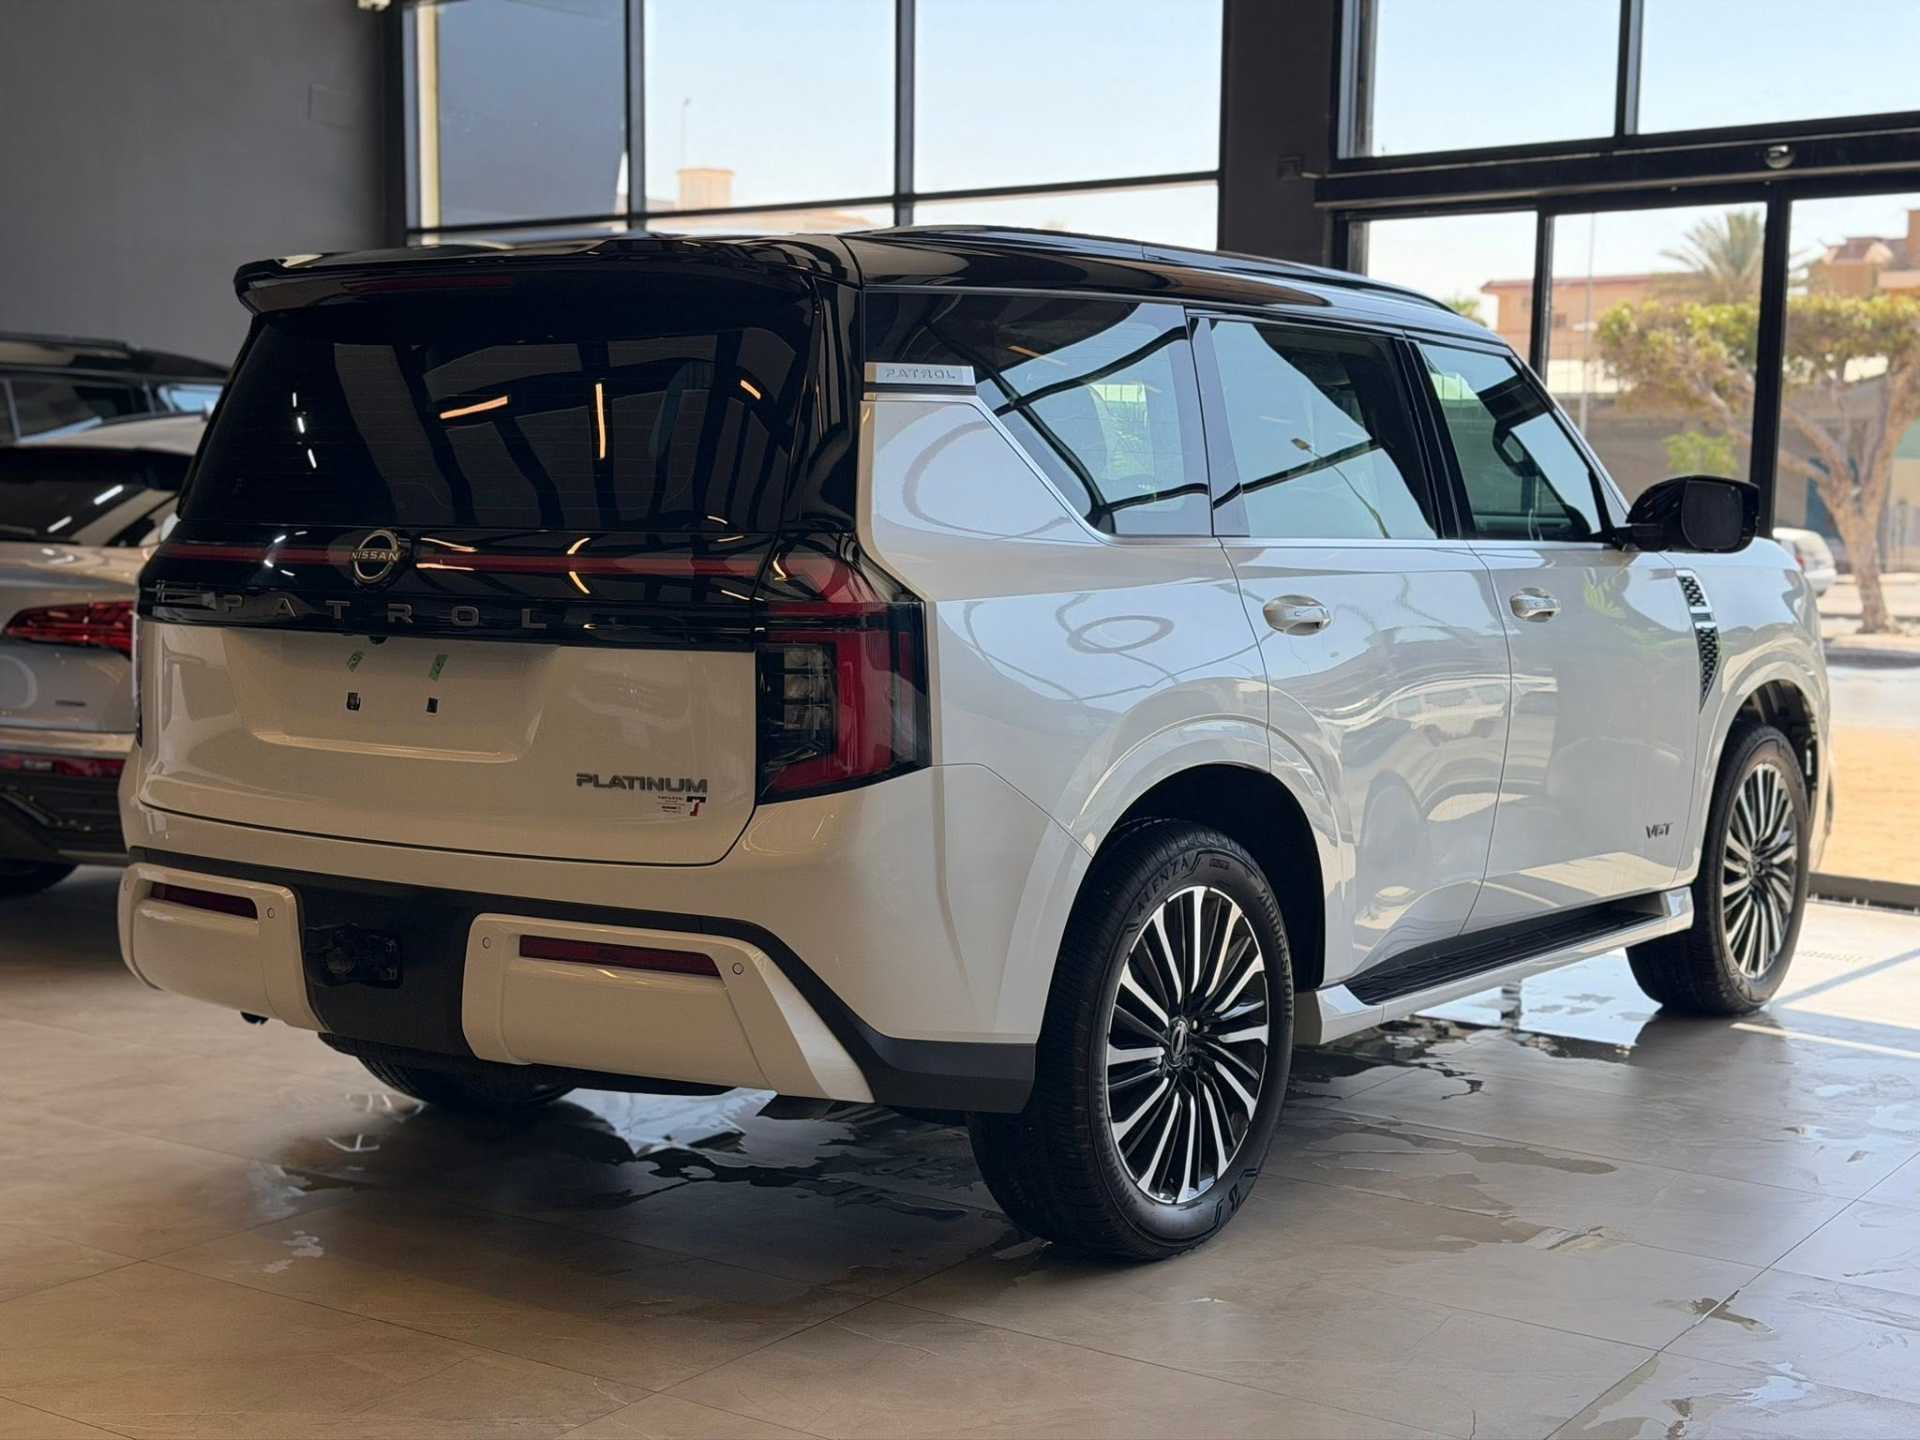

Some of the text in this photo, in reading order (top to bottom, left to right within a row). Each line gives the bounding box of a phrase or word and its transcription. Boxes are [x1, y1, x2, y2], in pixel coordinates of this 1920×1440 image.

[352, 550, 399, 561] NISSAN
[222, 594, 547, 630] PATROL
[576, 772, 708, 793] PLATINUM
